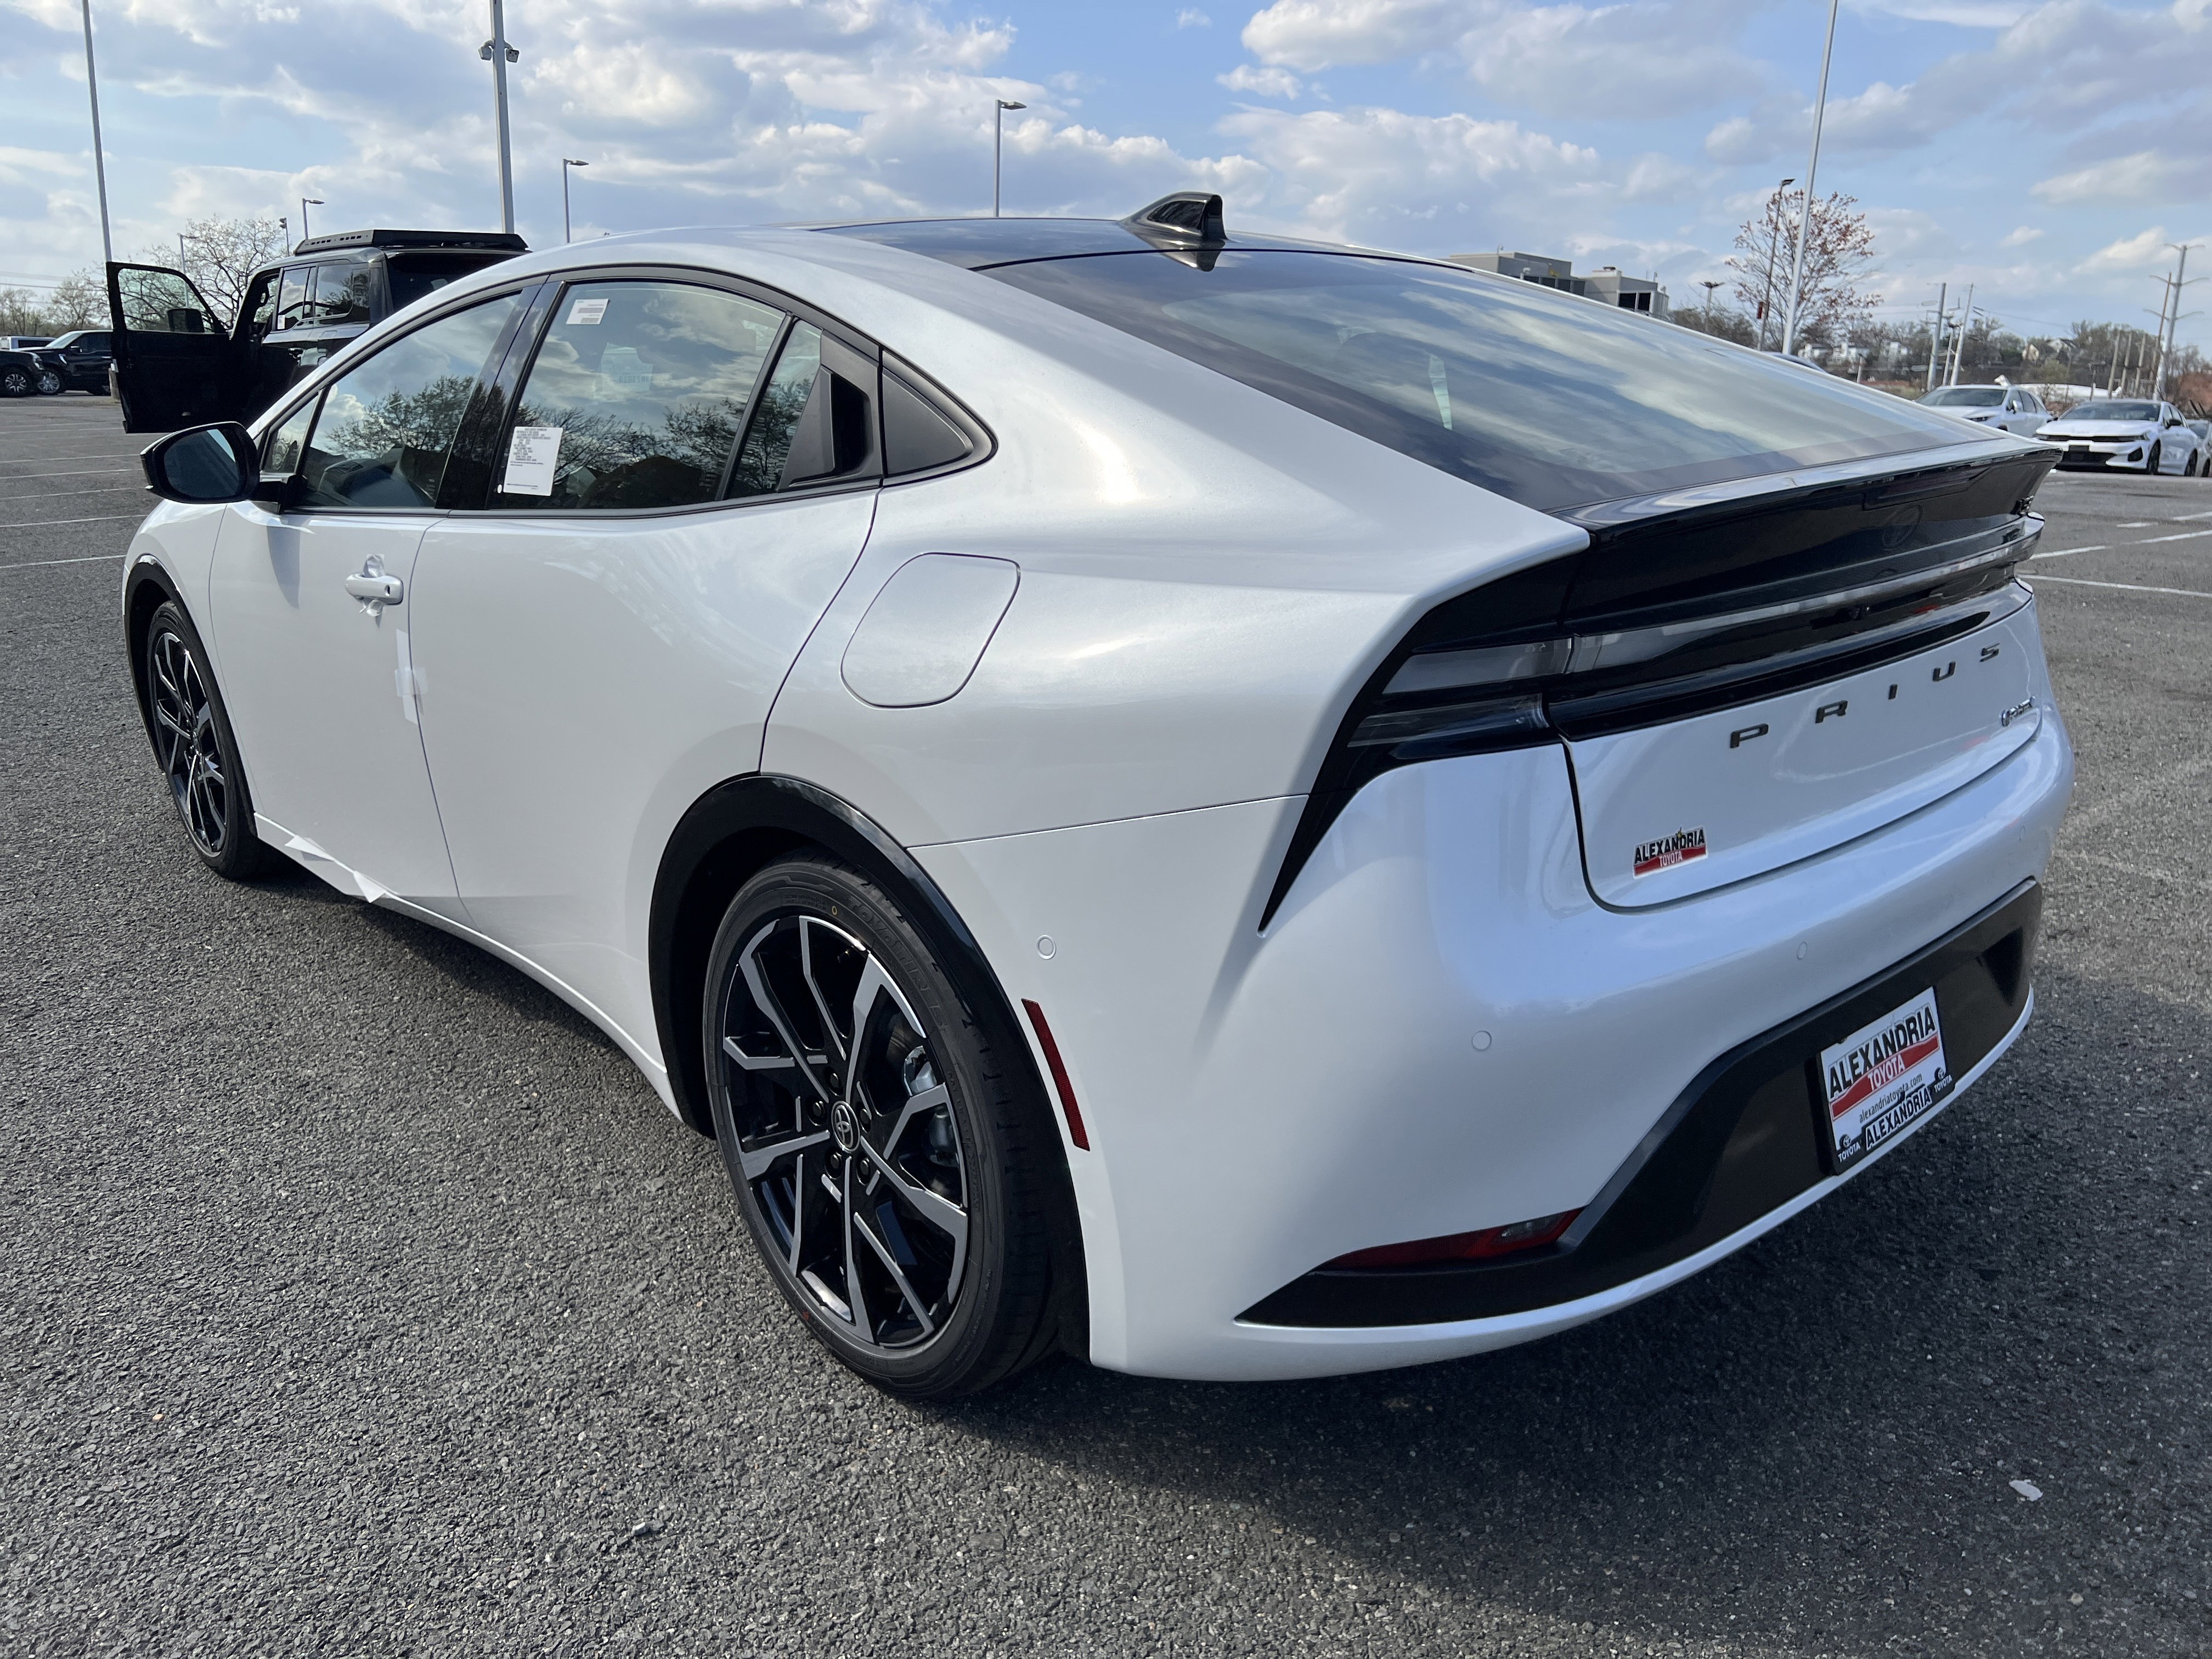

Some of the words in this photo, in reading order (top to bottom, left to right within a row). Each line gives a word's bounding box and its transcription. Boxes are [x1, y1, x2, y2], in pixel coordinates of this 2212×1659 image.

[1730, 642, 2000, 748] PRIUS
[1634, 829, 1705, 864] ALEXANDRIA
[1658, 850, 1683, 867] TOYOTA
[1829, 1006, 1936, 1099] ALEXANDRIA
[1867, 1054, 1906, 1091] TOYOTA
[1838, 1143, 1861, 1163] TOYOTA
[1865, 1086, 1932, 1150] ALEXANDRIA
[1934, 1074, 1953, 1093] TOYOTA
[1859, 1073, 1922, 1124] alexandriatoyota.com
